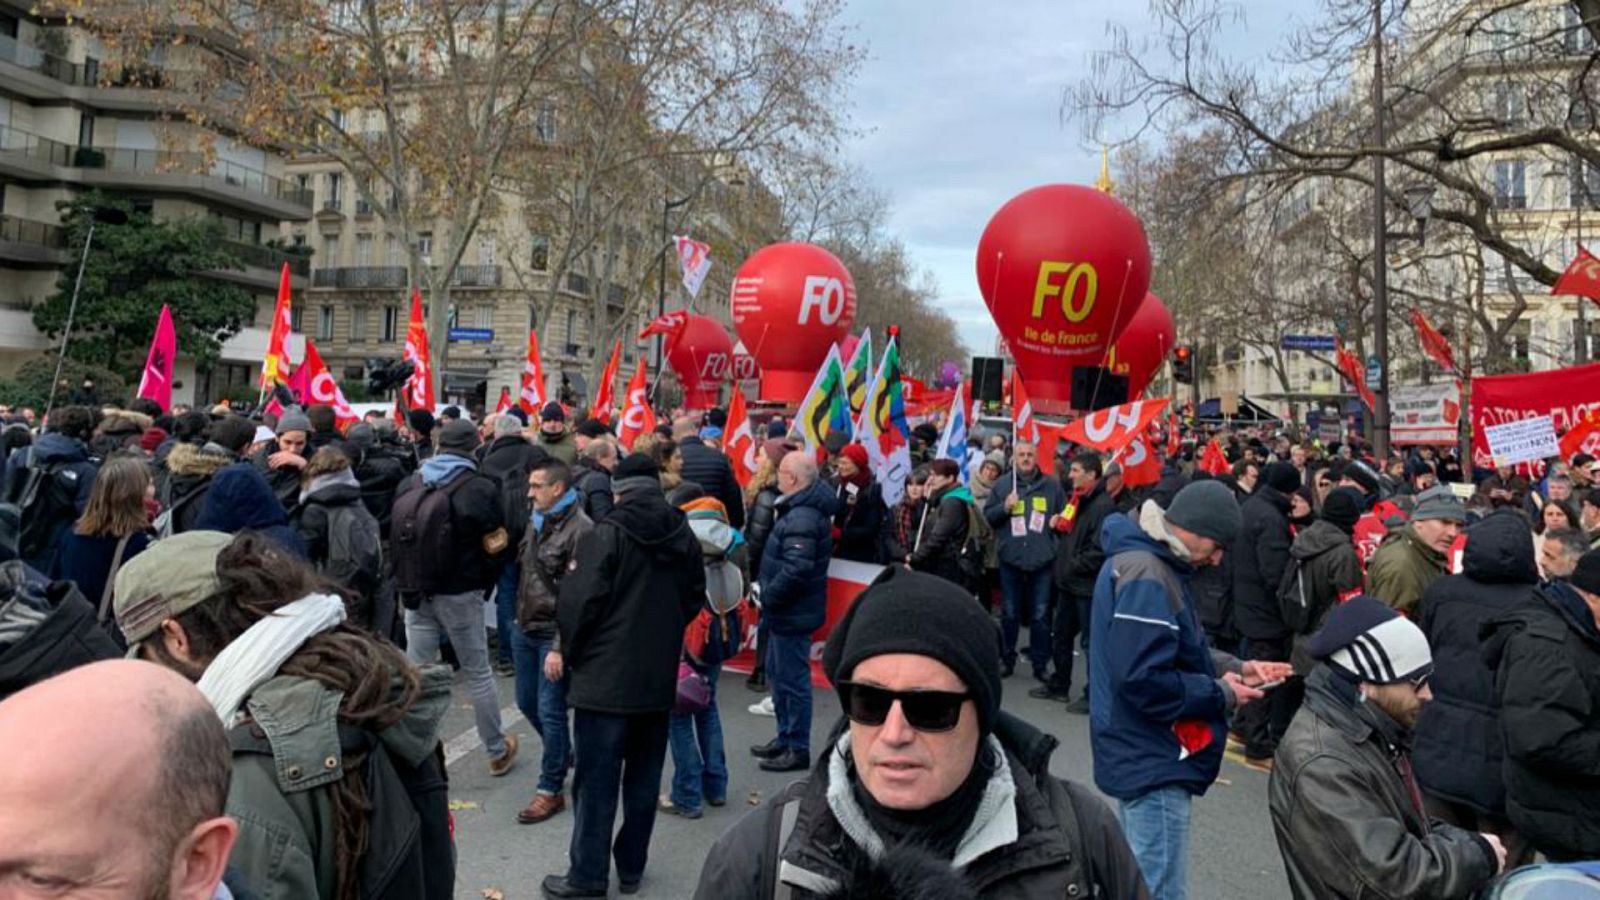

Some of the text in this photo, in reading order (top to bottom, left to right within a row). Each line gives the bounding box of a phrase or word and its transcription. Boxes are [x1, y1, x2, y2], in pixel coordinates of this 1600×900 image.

[797, 274, 845, 325] FO
[1031, 260, 1098, 322] FO
[1040, 328, 1056, 345] de
[701, 352, 728, 378] FO
[734, 355, 756, 379] FO
